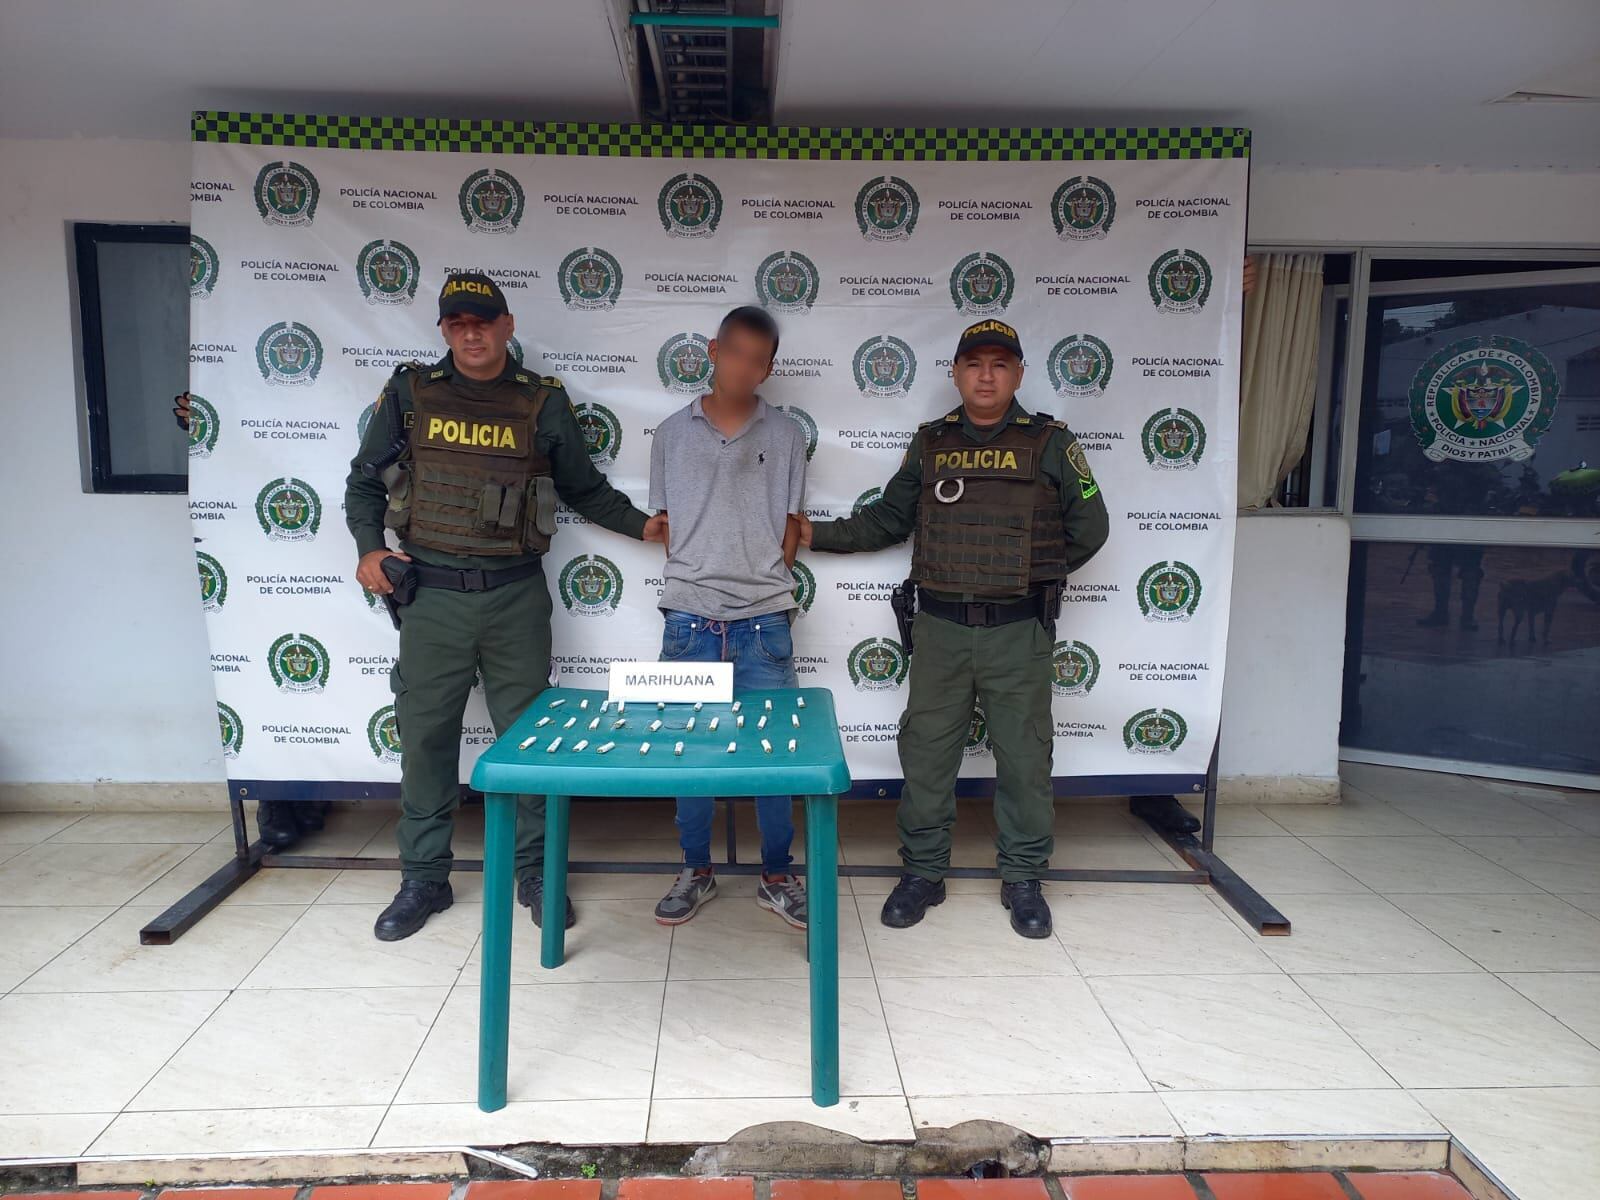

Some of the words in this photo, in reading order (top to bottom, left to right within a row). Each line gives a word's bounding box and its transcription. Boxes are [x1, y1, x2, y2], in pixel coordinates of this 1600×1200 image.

[191, 182, 235, 190] ACIONAL
[340, 188, 380, 197] POLICÍA
[384, 190, 437, 199] NACIONAL
[544, 194, 584, 203] POLICÍA
[587, 196, 638, 204] NACIONAL
[742, 199, 781, 207] POLICÍA
[784, 200, 835, 208] NACIONAL
[1178, 198, 1230, 207] NACIONAL
[369, 201, 424, 210] COLOMBIA
[939, 200, 978, 208] POLICÍA
[981, 201, 1032, 209] NACIONAL
[573, 207, 626, 215] COLOMBIA
[1164, 209, 1218, 218] COLOMBIA
[241, 260, 282, 269] POLICÍA
[285, 262, 339, 271] NACIONAL
[271, 273, 326, 282] COLOMBIA
[488, 270, 540, 278] NACIONAL
[645, 273, 684, 281] POLICÍA
[840, 276, 879, 284] POLICÍA
[882, 277, 933, 285] NACIONAL
[1074, 276, 1130, 284] NACIONAL
[673, 285, 726, 293] COLOMBIA
[868, 288, 920, 296] COLOMBIA
[1064, 287, 1118, 295] COLOMBIA
[191, 344, 237, 352] ACIONAL
[342, 347, 383, 355] POLICÍA
[386, 349, 440, 358] NACIONAL
[543, 352, 583, 361] POLICÍA
[586, 354, 638, 362] NACIONAL
[1132, 357, 1169, 365] POLICÍA
[1173, 358, 1224, 366] NACIONAL
[355, 359, 368, 367] DE
[372, 359, 399, 367] COLO
[782, 358, 832, 366] NACIONAL
[572, 365, 625, 373] COLOMBIA
[1427, 356, 1466, 407] REPUBLICA
[1478, 350, 1495, 358] DE
[1506, 354, 1539, 405] COLOMBIA
[241, 419, 282, 427] POLICÍA
[286, 421, 340, 429] NACIONAL
[428, 418, 516, 449] POLICIA
[839, 429, 878, 438] POLICÍA
[1432, 418, 1466, 446] POLICIA
[1479, 415, 1532, 447] NACIONAL
[271, 432, 326, 440] COLOMBIA
[1074, 432, 1124, 440] NACIONAL
[868, 442, 912, 450] COLOMB
[1441, 443, 1466, 458] DIOS
[1478, 444, 1517, 458] PATRIA
[934, 450, 1018, 473] POLICIA
[188, 501, 237, 509] ACIONAL
[1128, 510, 1166, 519] POLICÍA
[247, 574, 287, 583] POLICÍA
[837, 582, 875, 590] POLICÍA
[865, 593, 893, 601] COLO
[1063, 594, 1107, 603] OLOMBIA
[210, 654, 251, 662] ACIONAL
[349, 655, 389, 664] POLICÍA
[625, 675, 715, 686] MARIHUANA
[262, 725, 299, 733] POLICÍA
[461, 726, 492, 734] OLICÍA
[840, 723, 872, 732] OLICÍA
[1057, 722, 1106, 730] NACIONAL
[863, 734, 899, 742] COLOM
[1051, 730, 1094, 739] OLOMBIA
